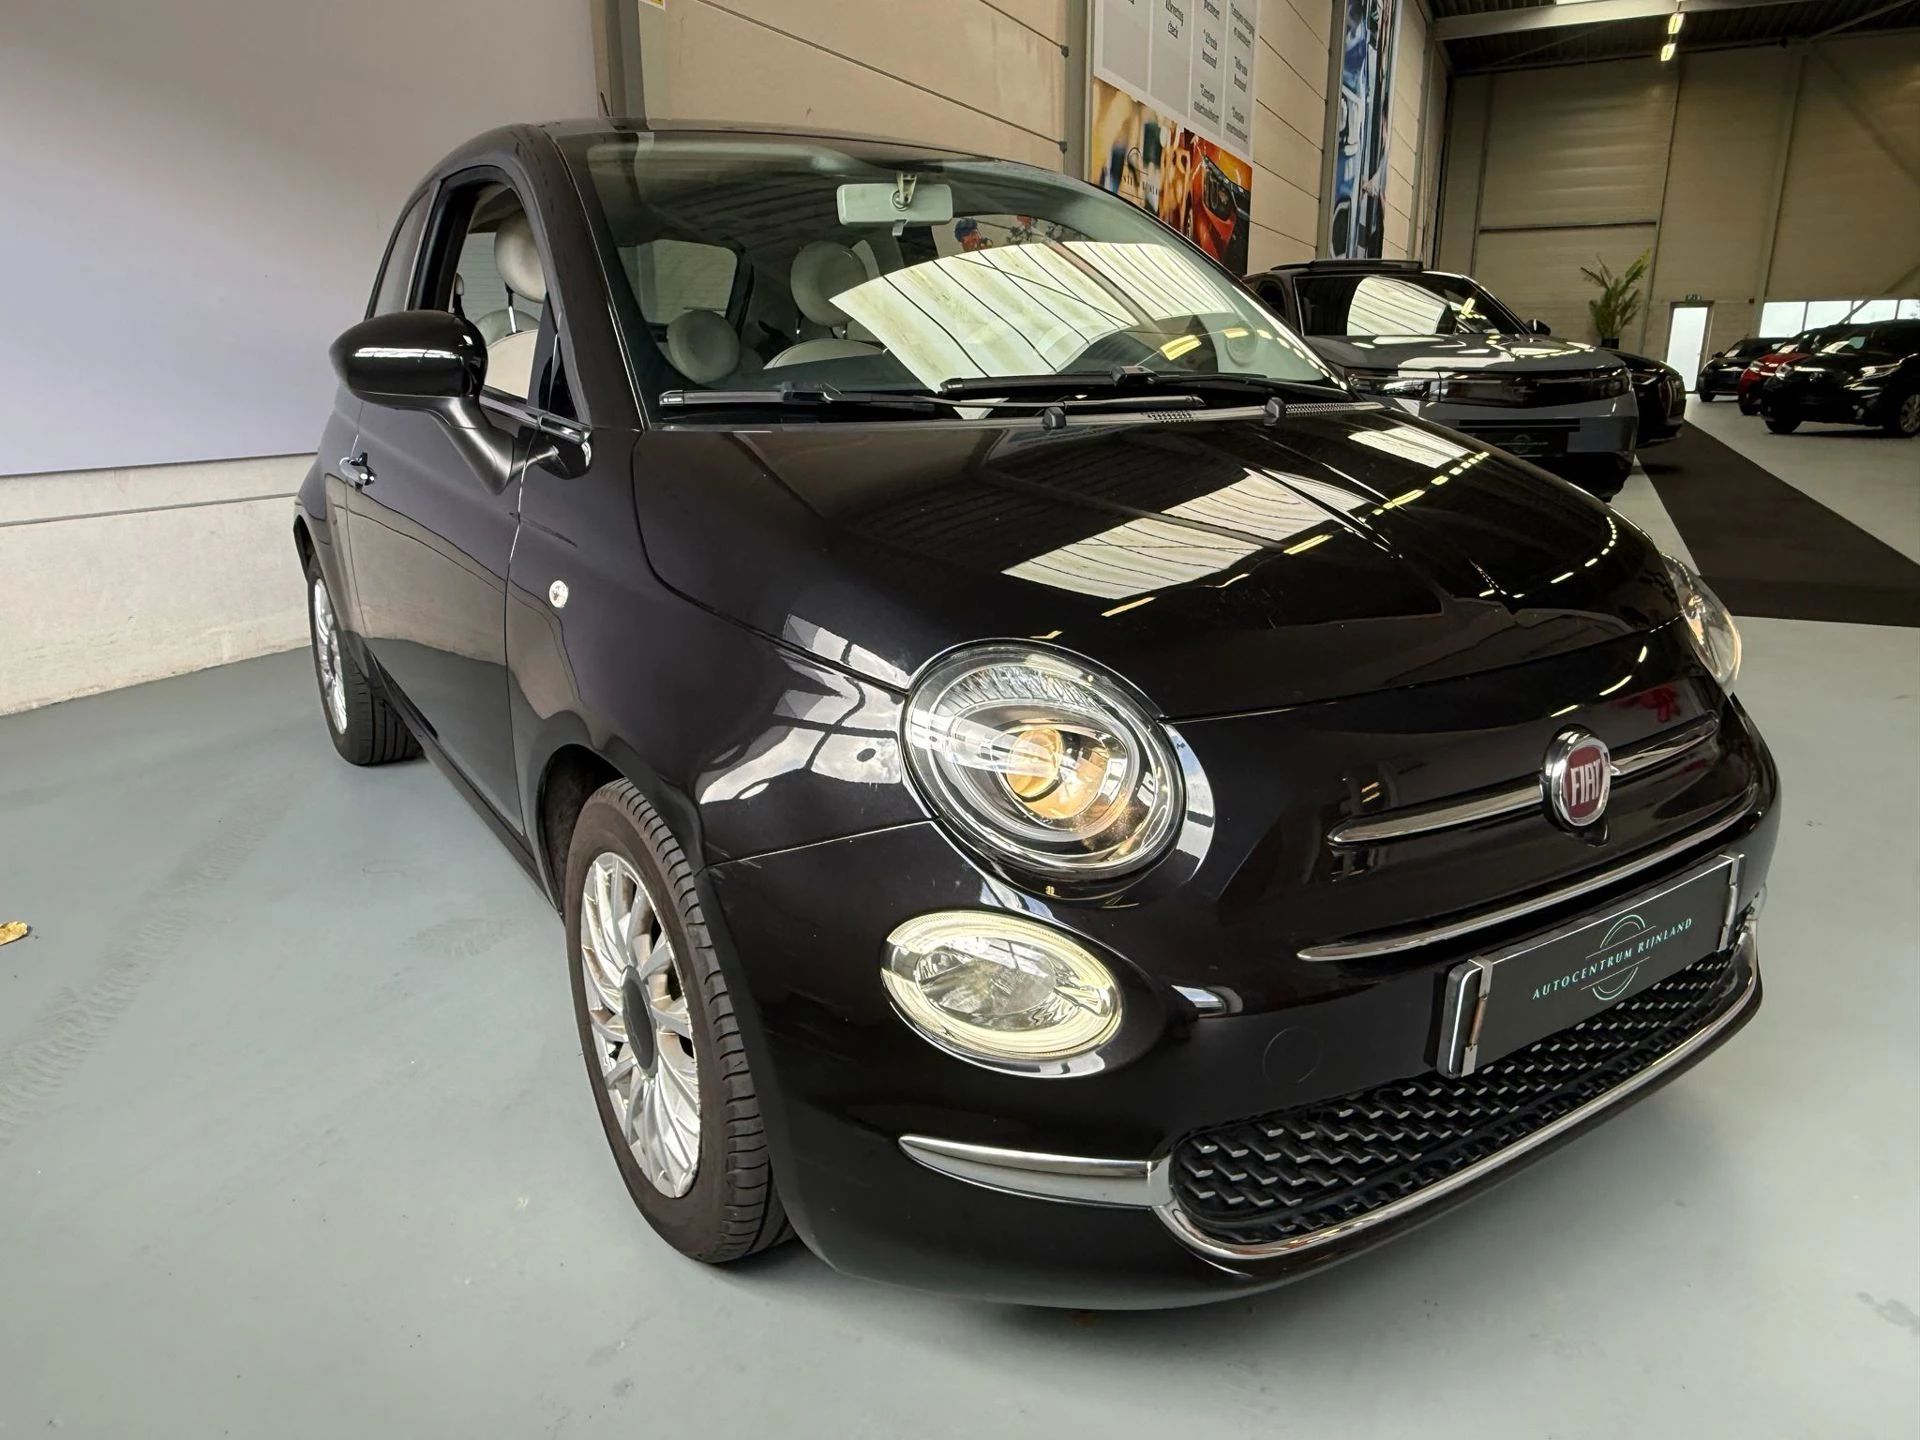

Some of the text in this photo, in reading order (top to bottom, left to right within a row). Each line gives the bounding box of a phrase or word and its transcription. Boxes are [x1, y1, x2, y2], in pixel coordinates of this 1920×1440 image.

[1570, 759, 1601, 807] FIAT
[1532, 917, 1693, 1000] AUTOCENTRUM RIJNLAND
